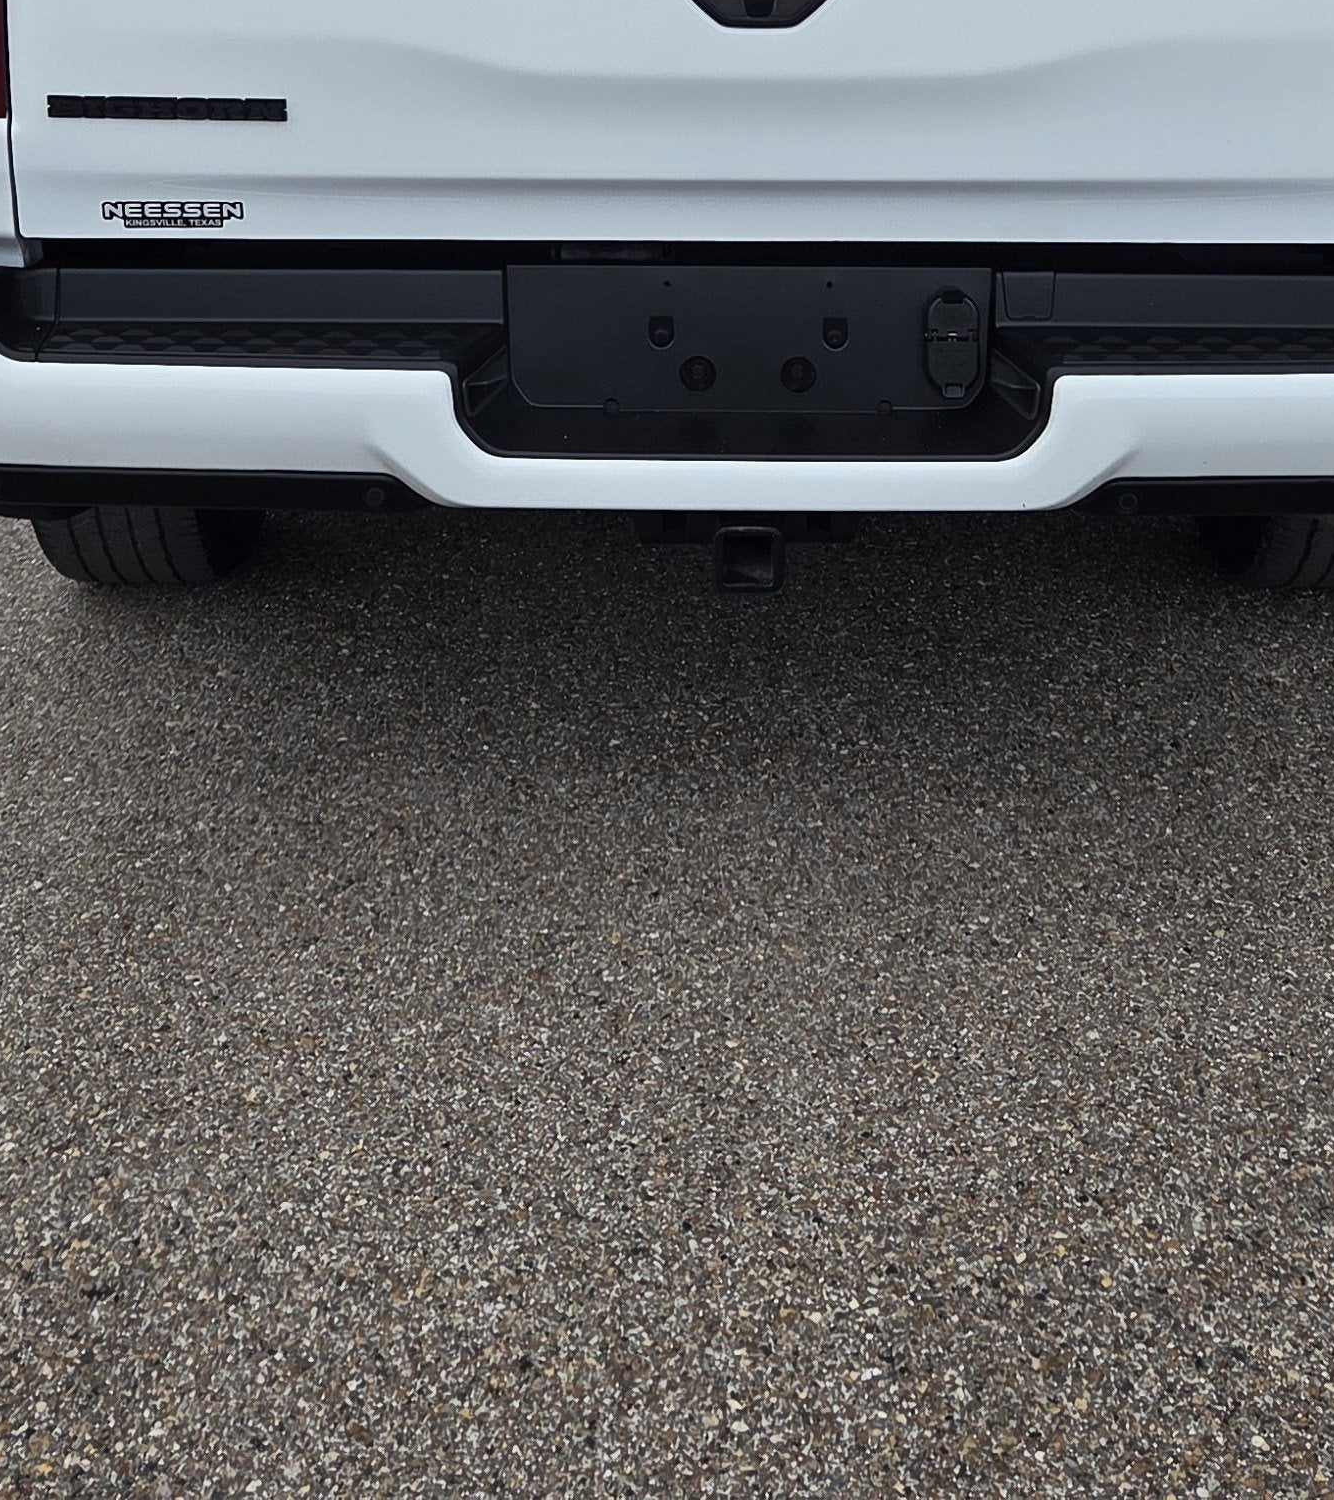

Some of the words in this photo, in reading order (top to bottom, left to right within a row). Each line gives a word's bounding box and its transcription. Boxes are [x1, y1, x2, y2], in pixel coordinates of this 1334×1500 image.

[103, 202, 242, 218] NEESSEN
[125, 219, 187, 227] KINGSVILLE,
[189, 219, 222, 227] TEXAS
